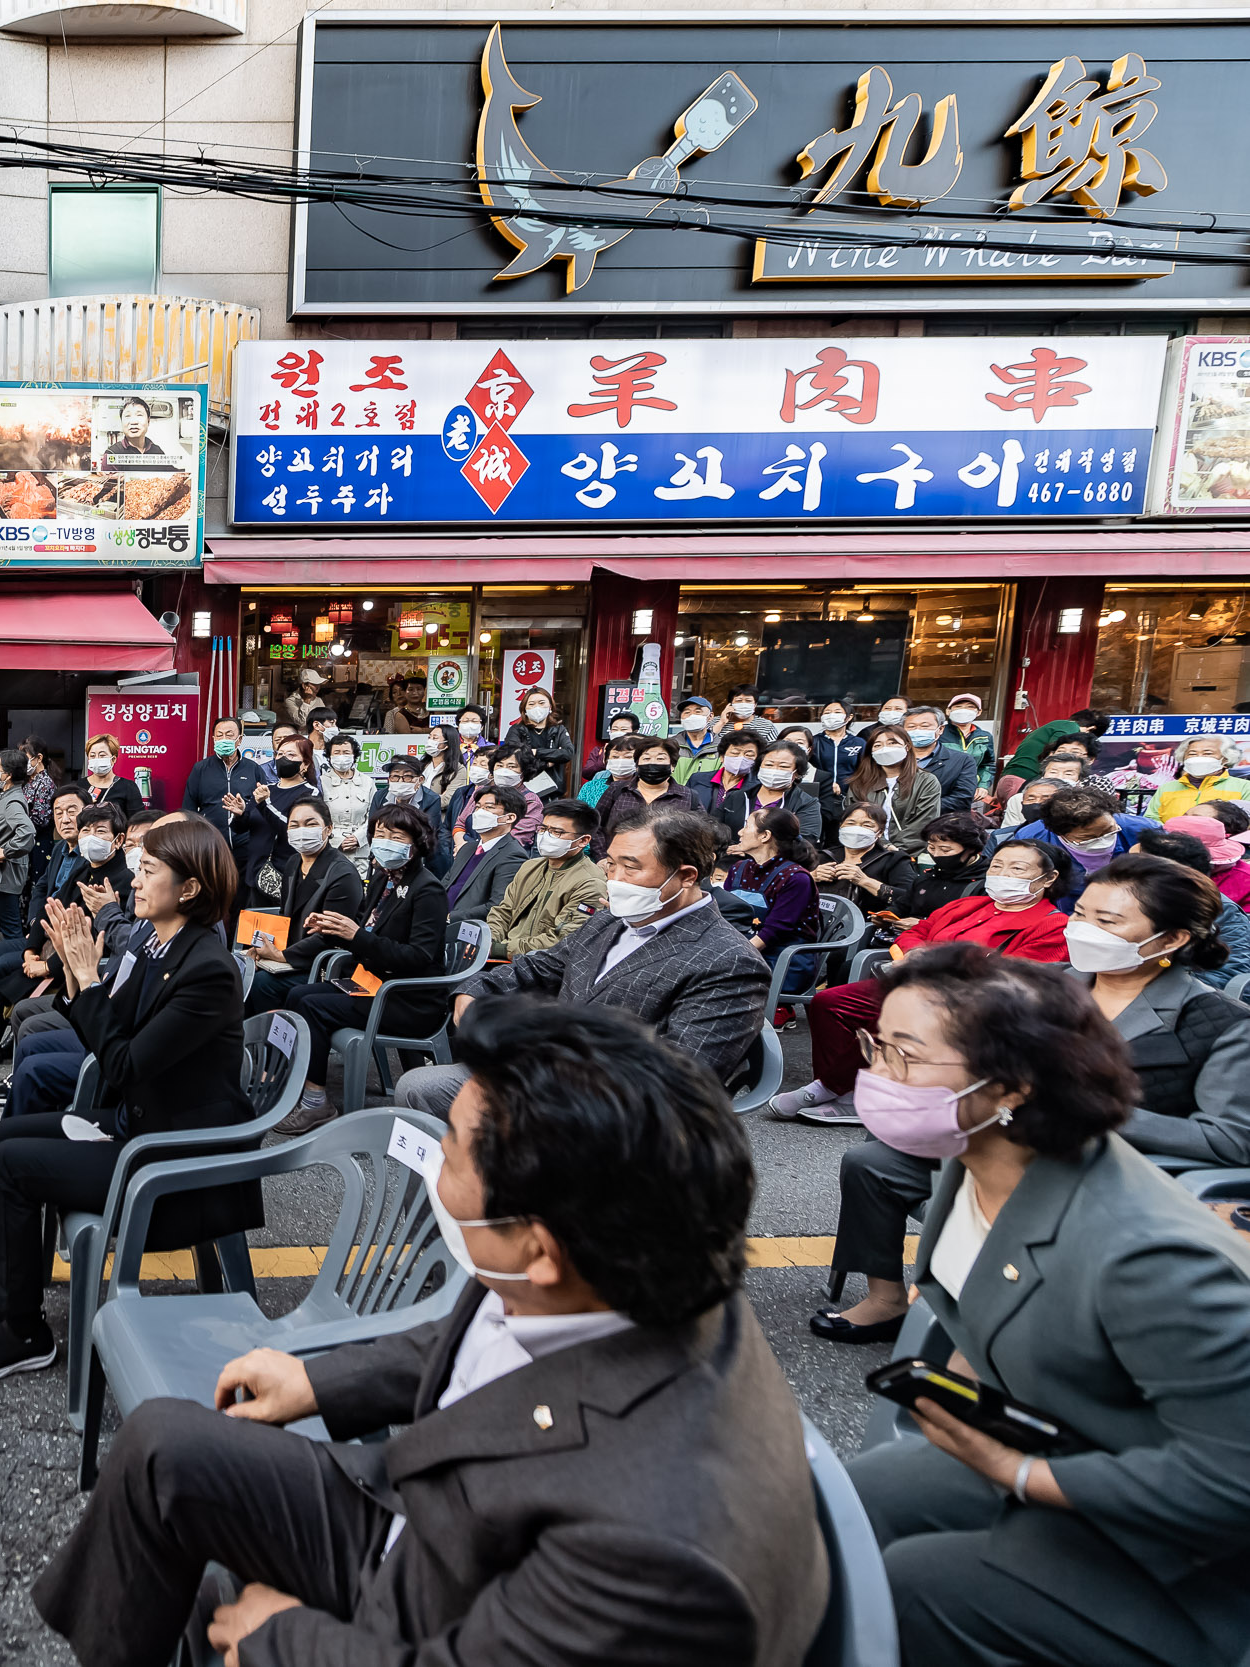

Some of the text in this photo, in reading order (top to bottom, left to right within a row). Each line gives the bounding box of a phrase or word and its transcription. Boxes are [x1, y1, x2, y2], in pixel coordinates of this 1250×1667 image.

[271, 349, 409, 398] 원조
[1198, 352, 1237, 367] KBS
[567, 347, 1092, 428] 羊肉串
[256, 444, 414, 478] 양꼬치거리
[560, 438, 1026, 511] 양꼬치구이
[1027, 481, 1134, 504] 467-6880
[101, 704, 187, 722] 경성양꼬치
[120, 745, 168, 754] TSINGTAO
